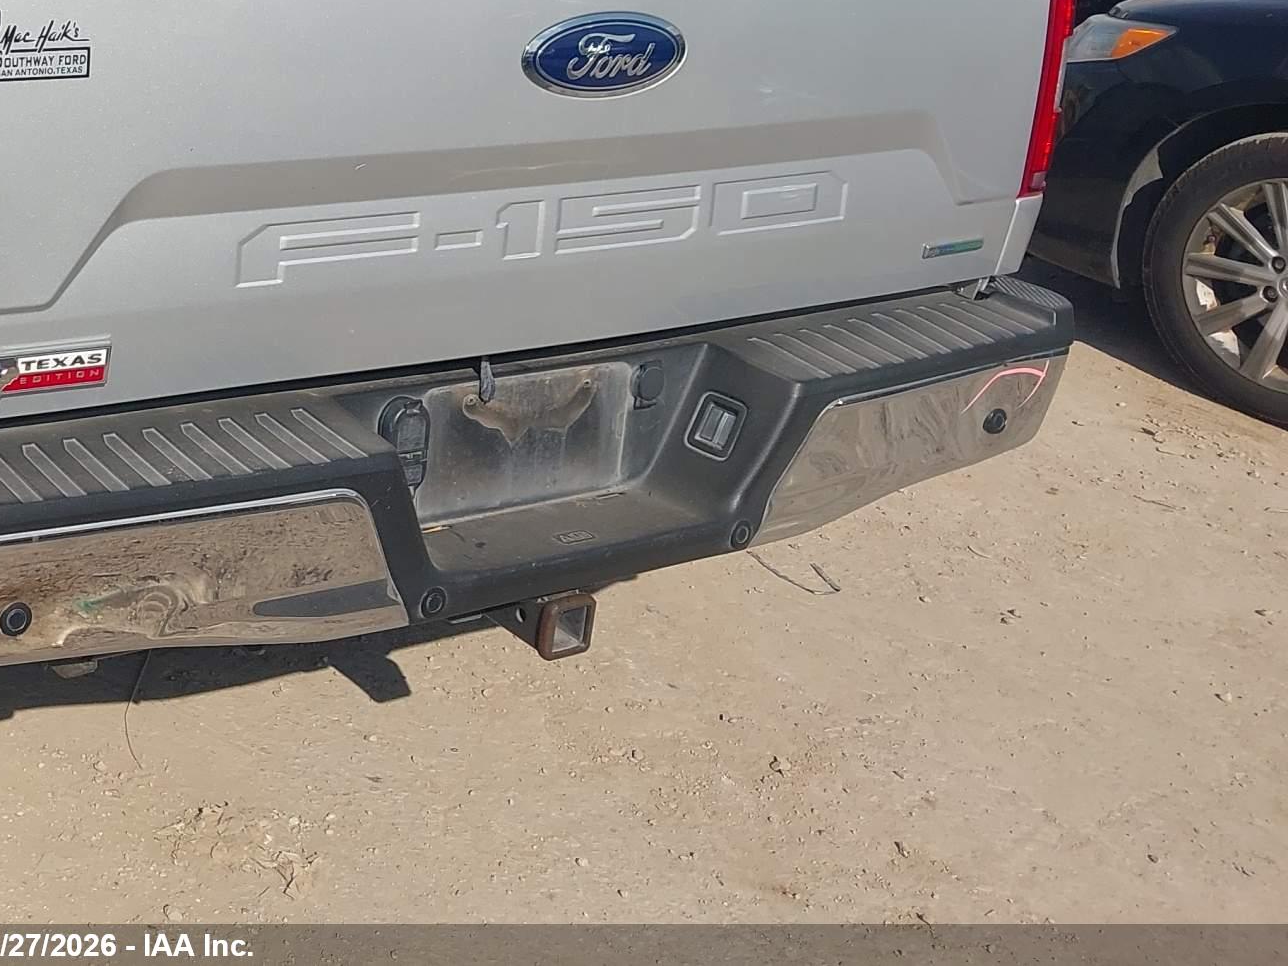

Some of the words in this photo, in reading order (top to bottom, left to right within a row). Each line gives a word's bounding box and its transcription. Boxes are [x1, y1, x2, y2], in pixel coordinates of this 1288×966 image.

[35, 19, 90, 54] Haik's
[58, 54, 87, 66] FORD
[566, 32, 656, 80] Ford
[234, 170, 849, 288] F-150
[21, 353, 103, 371] TEXAS
[20, 370, 100, 385] EDITION
